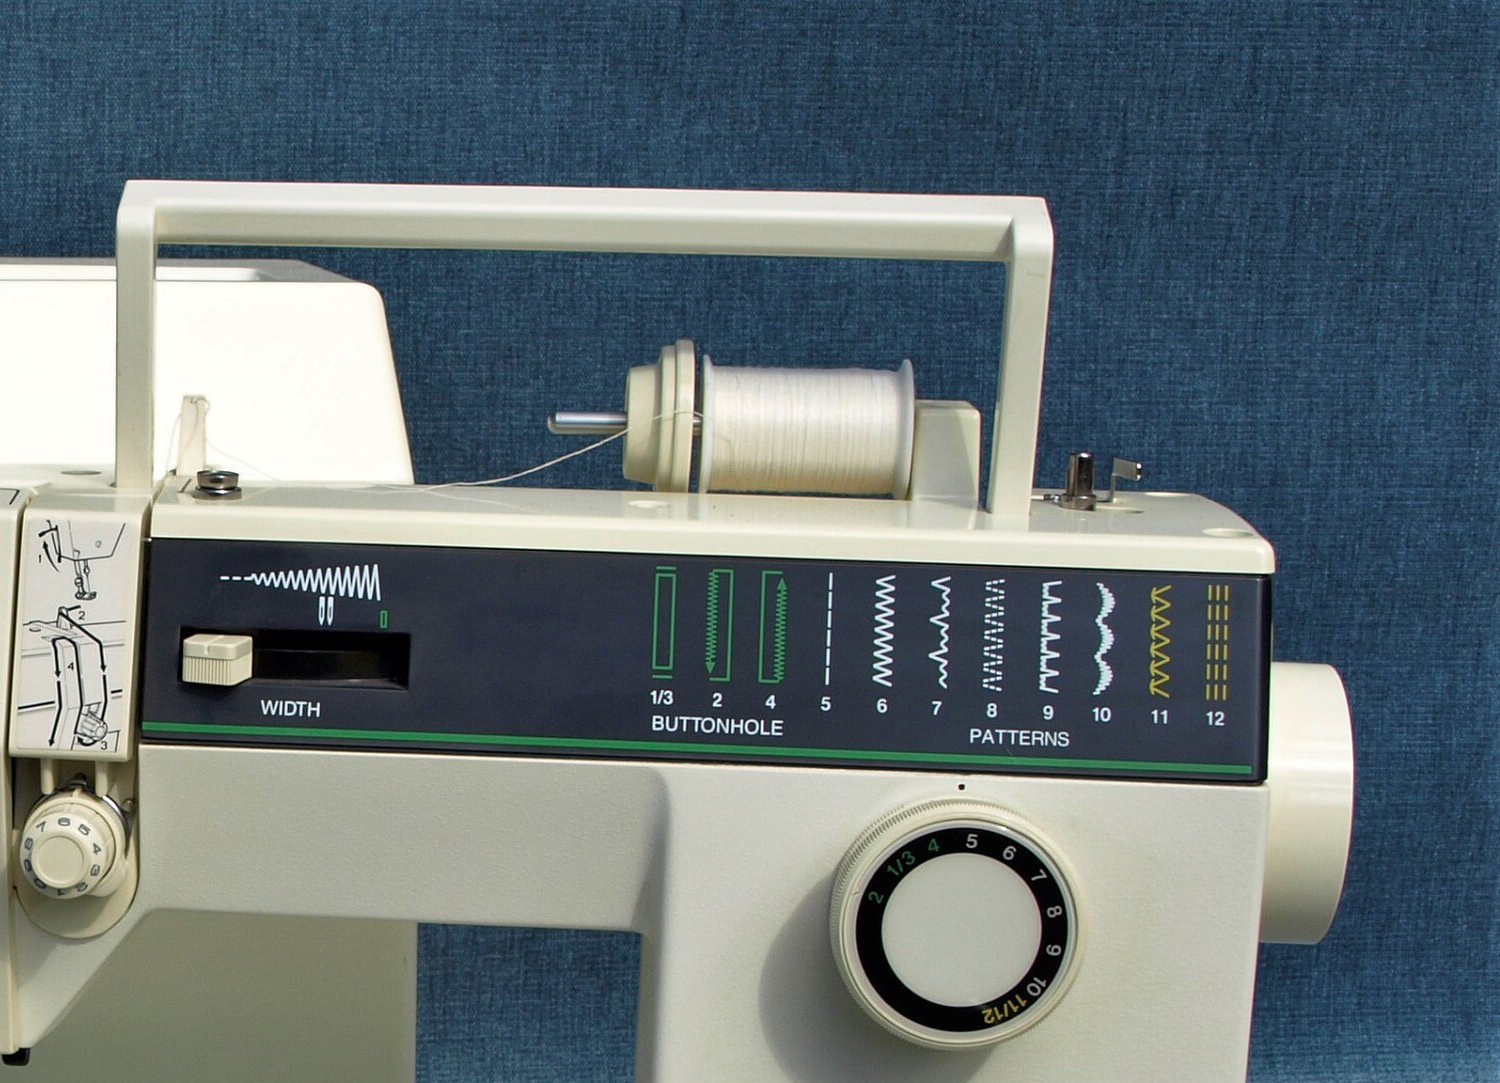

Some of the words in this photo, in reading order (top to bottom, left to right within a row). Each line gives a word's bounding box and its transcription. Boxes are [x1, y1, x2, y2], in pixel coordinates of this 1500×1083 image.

[260, 699, 321, 718] WIDTH
[650, 690, 674, 705] 1/3
[712, 692, 723, 708] 2
[765, 695, 777, 710] 4
[820, 696, 832, 712] 5
[876, 698, 888, 714] 6
[931, 700, 943, 716] 7
[986, 702, 998, 718] 8
[1042, 704, 1054, 720] 9
[1092, 706, 1112, 722] 10
[1151, 709, 1168, 725] 11
[1206, 711, 1225, 726] 12
[651, 715, 784, 736] BUTTONHOLE
[969, 728, 1070, 747] PATTERNS
[927, 838, 940, 853] 4
[966, 833, 978, 849] 5
[1003, 845, 1017, 861] 6
[886, 850, 916, 877] 1/3
[1030, 868, 1048, 883] 7
[868, 890, 884, 905] 2
[1046, 905, 1062, 918] 8
[1046, 944, 1062, 957] 9
[1026, 976, 1048, 997] 10
[981, 993, 1027, 1024] 11/12
